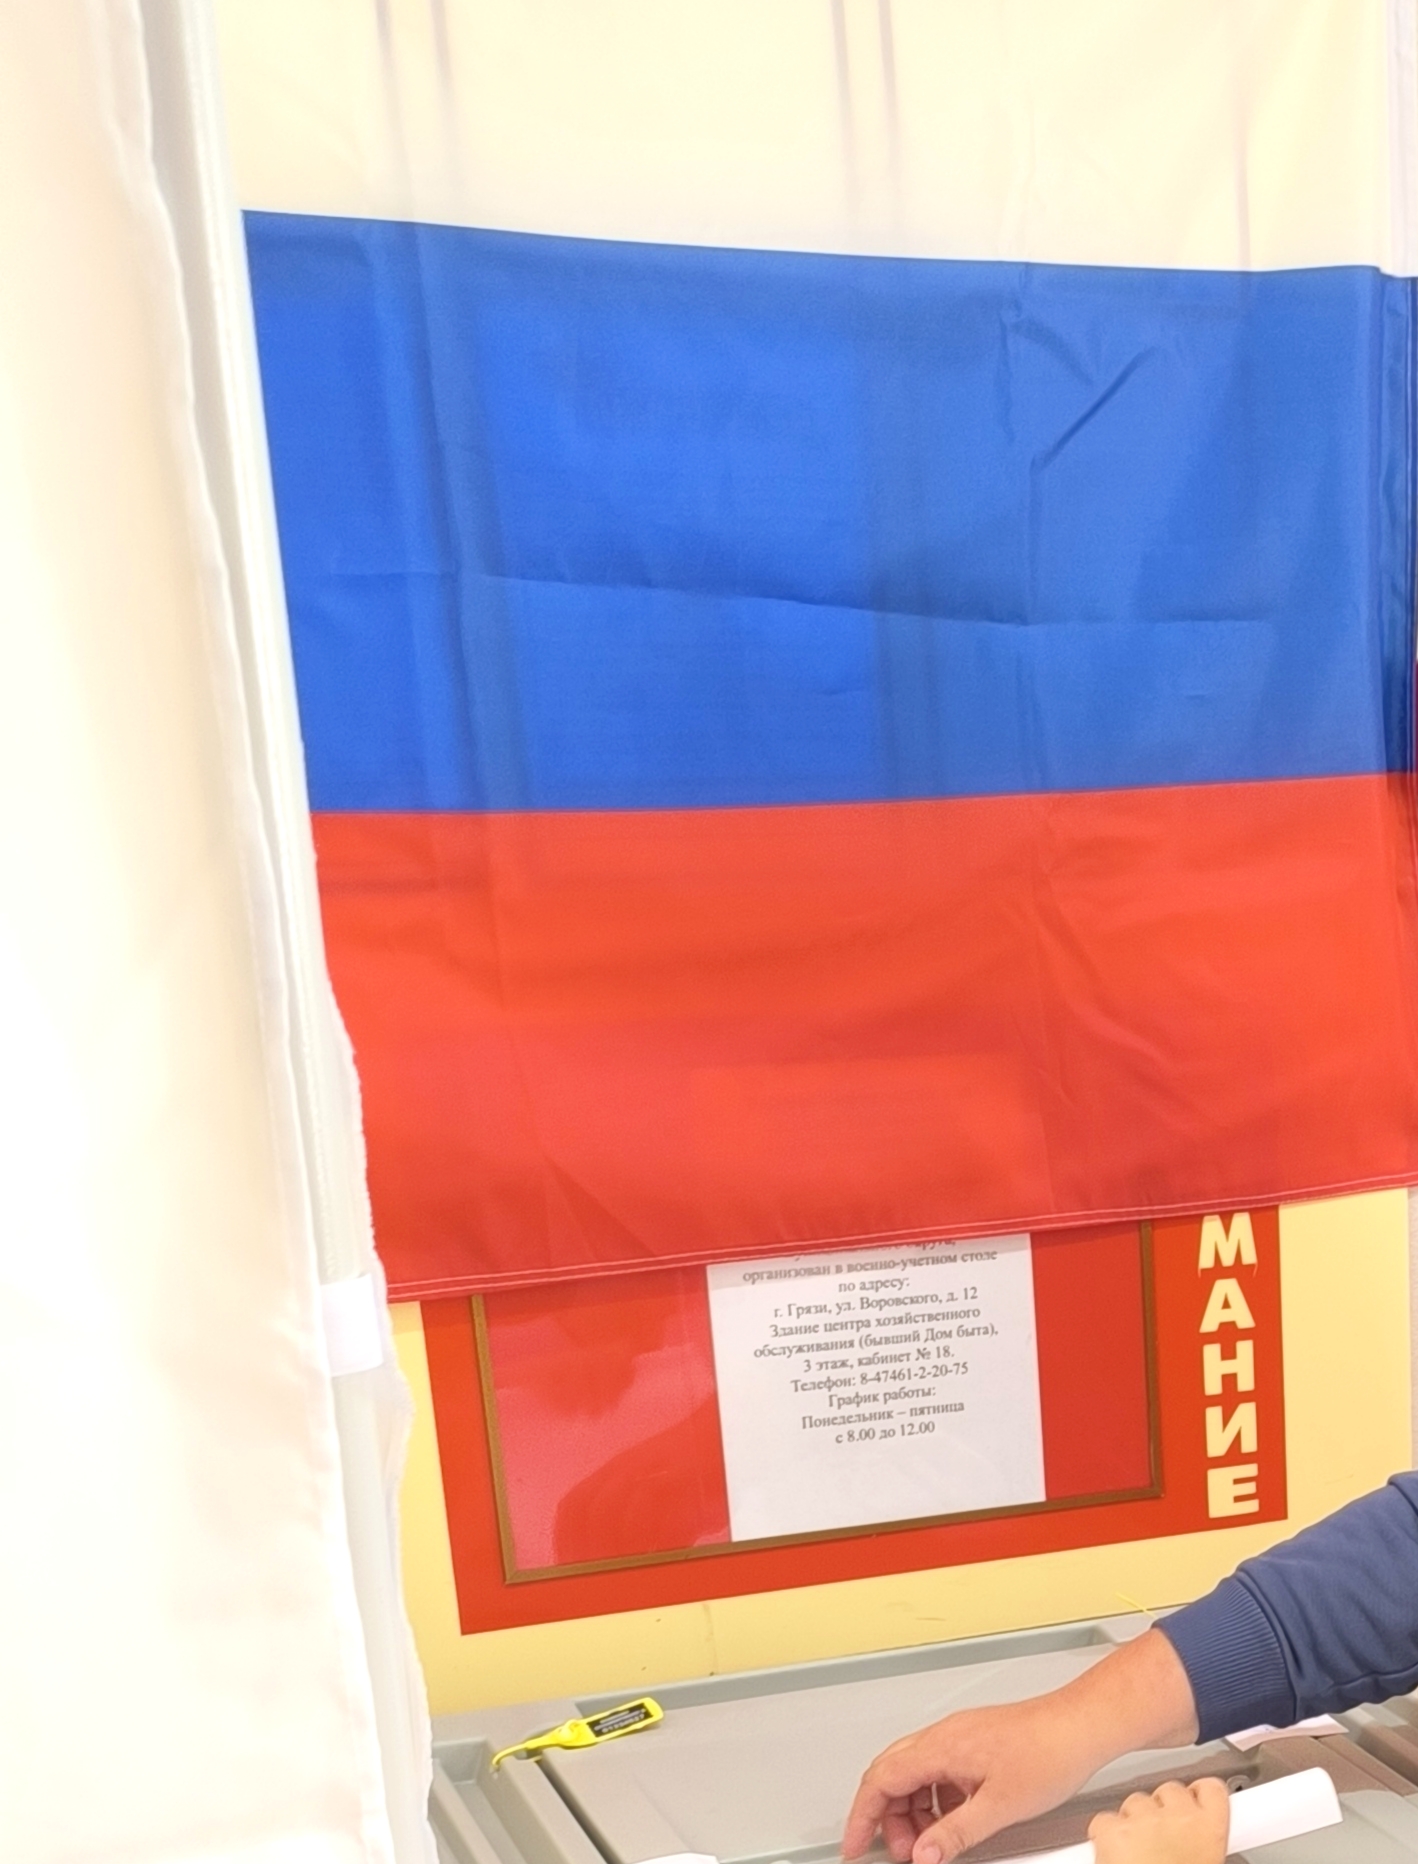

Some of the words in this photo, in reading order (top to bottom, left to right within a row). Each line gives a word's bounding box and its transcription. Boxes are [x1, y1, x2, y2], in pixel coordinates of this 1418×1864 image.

[743, 1265, 831, 1286] организован
[834, 1264, 844, 1275] в
[847, 1252, 958, 1275] военно-учетном
[961, 1249, 998, 1264] столе
[838, 1281, 856, 1293] по
[859, 1276, 910, 1293] адресу:
[774, 1307, 784, 1318] г.
[787, 1303, 833, 1319] Грязи,
[836, 1301, 857, 1316] ул.
[860, 1294, 943, 1312] Воровского,
[946, 1291, 959, 1304] д.
[963, 1286, 979, 1301] 12
[769, 1322, 820, 1338] Здание
[824, 1318, 871, 1334] центра
[875, 1307, 981, 1327] хозяйственного
[753, 1338, 855, 1360] обслуживания
[858, 1331, 921, 1350] (бывший
[924, 1327, 953, 1344] Дом
[957, 1322, 999, 1339] быта),
[803, 1359, 812, 1373] 3
[816, 1358, 854, 1372] этаж,
[857, 1352, 911, 1368] кабинет
[915, 1348, 931, 1361] №
[935, 1345, 955, 1359] 18.
[790, 1376, 856, 1394] Телефон:
[860, 1361, 969, 1385] 8-47461-2-20-75
[828, 1391, 880, 1410] График
[883, 1386, 936, 1405] работы:
[801, 1409, 894, 1430] Понедельник
[909, 1401, 965, 1418] пятница
[835, 1434, 843, 1444] с
[847, 1426, 876, 1443] 8.00
[879, 1427, 896, 1440] до
[900, 1420, 935, 1438] 12.00
